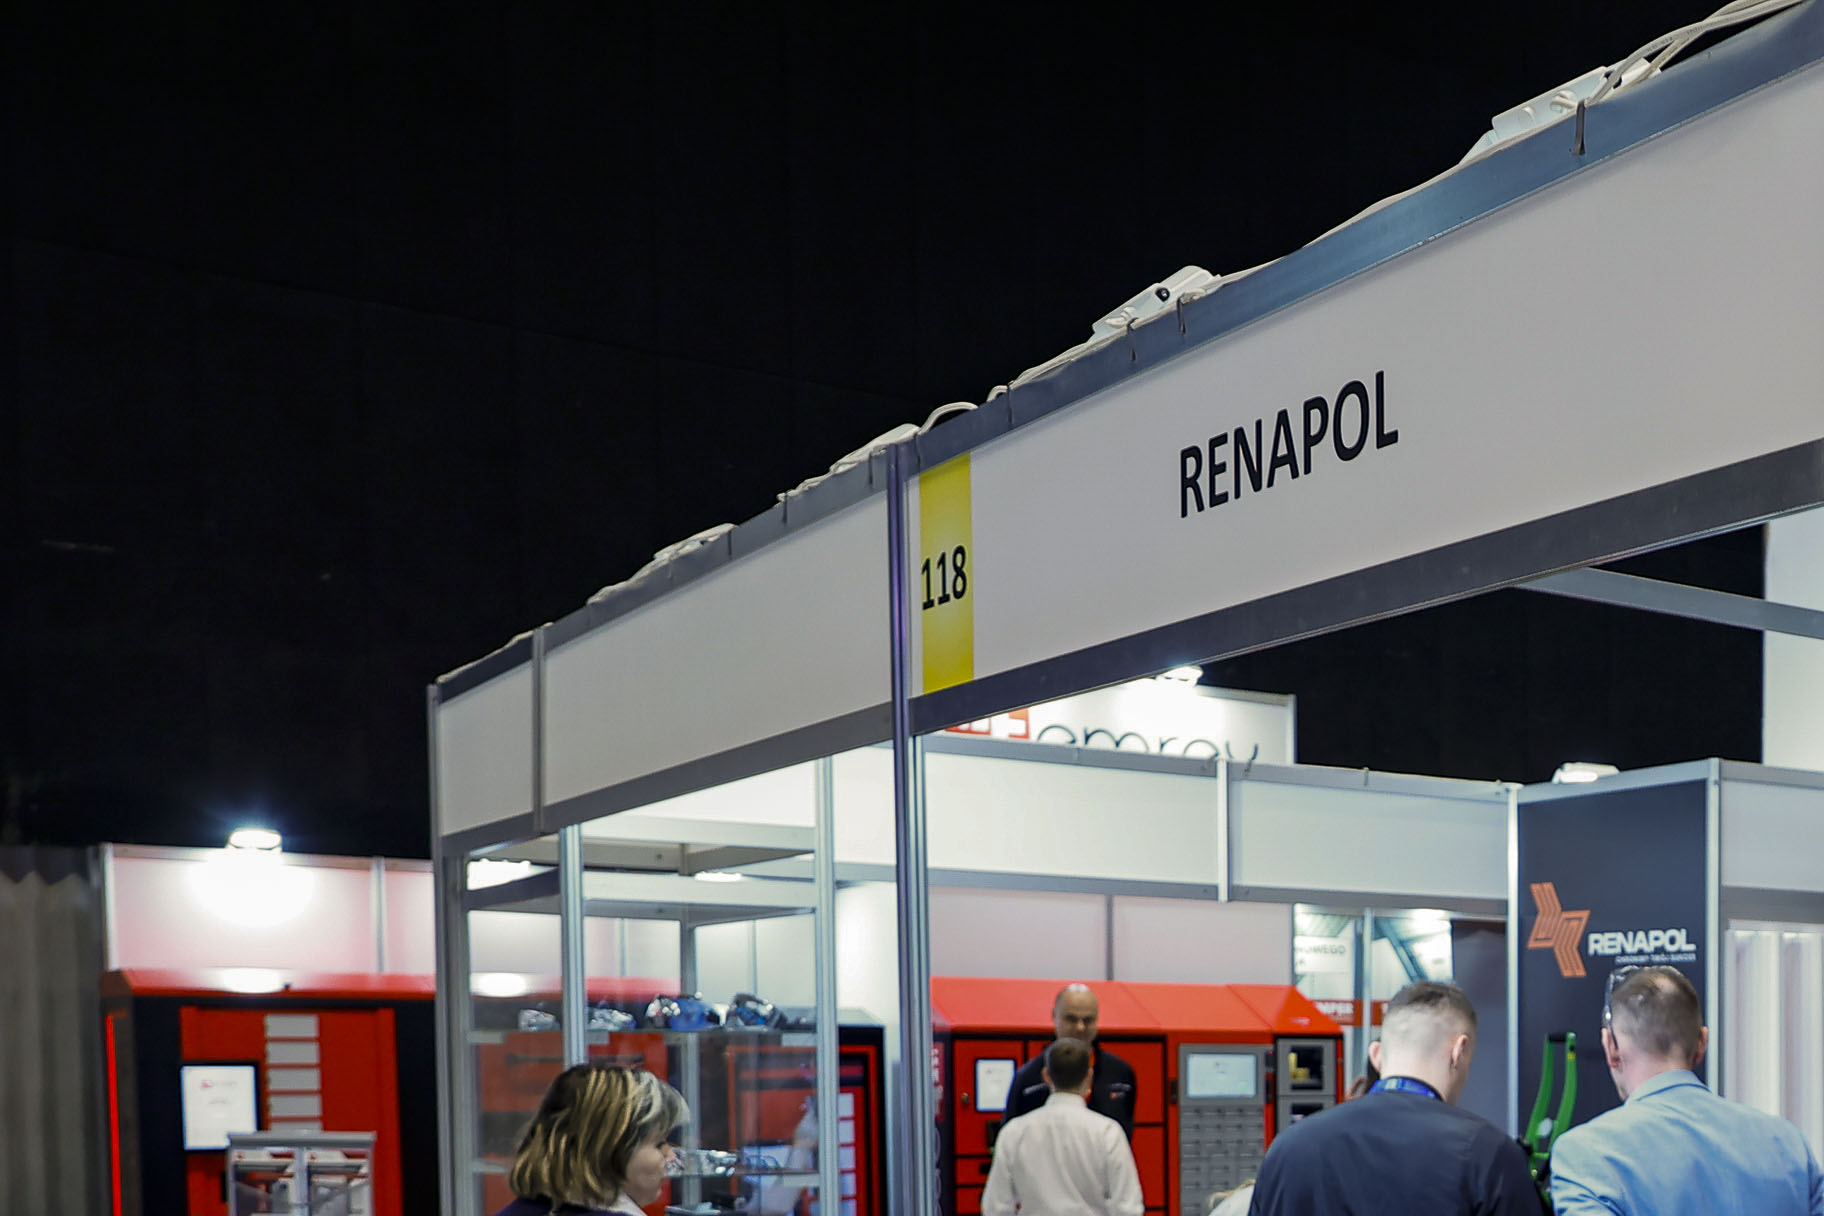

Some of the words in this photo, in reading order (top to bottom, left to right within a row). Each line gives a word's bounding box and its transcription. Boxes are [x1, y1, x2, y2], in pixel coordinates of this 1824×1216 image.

[1180, 370, 1399, 518] RENAPOL
[921, 545, 967, 610] 118
[1588, 927, 1697, 956] RENAPOL
